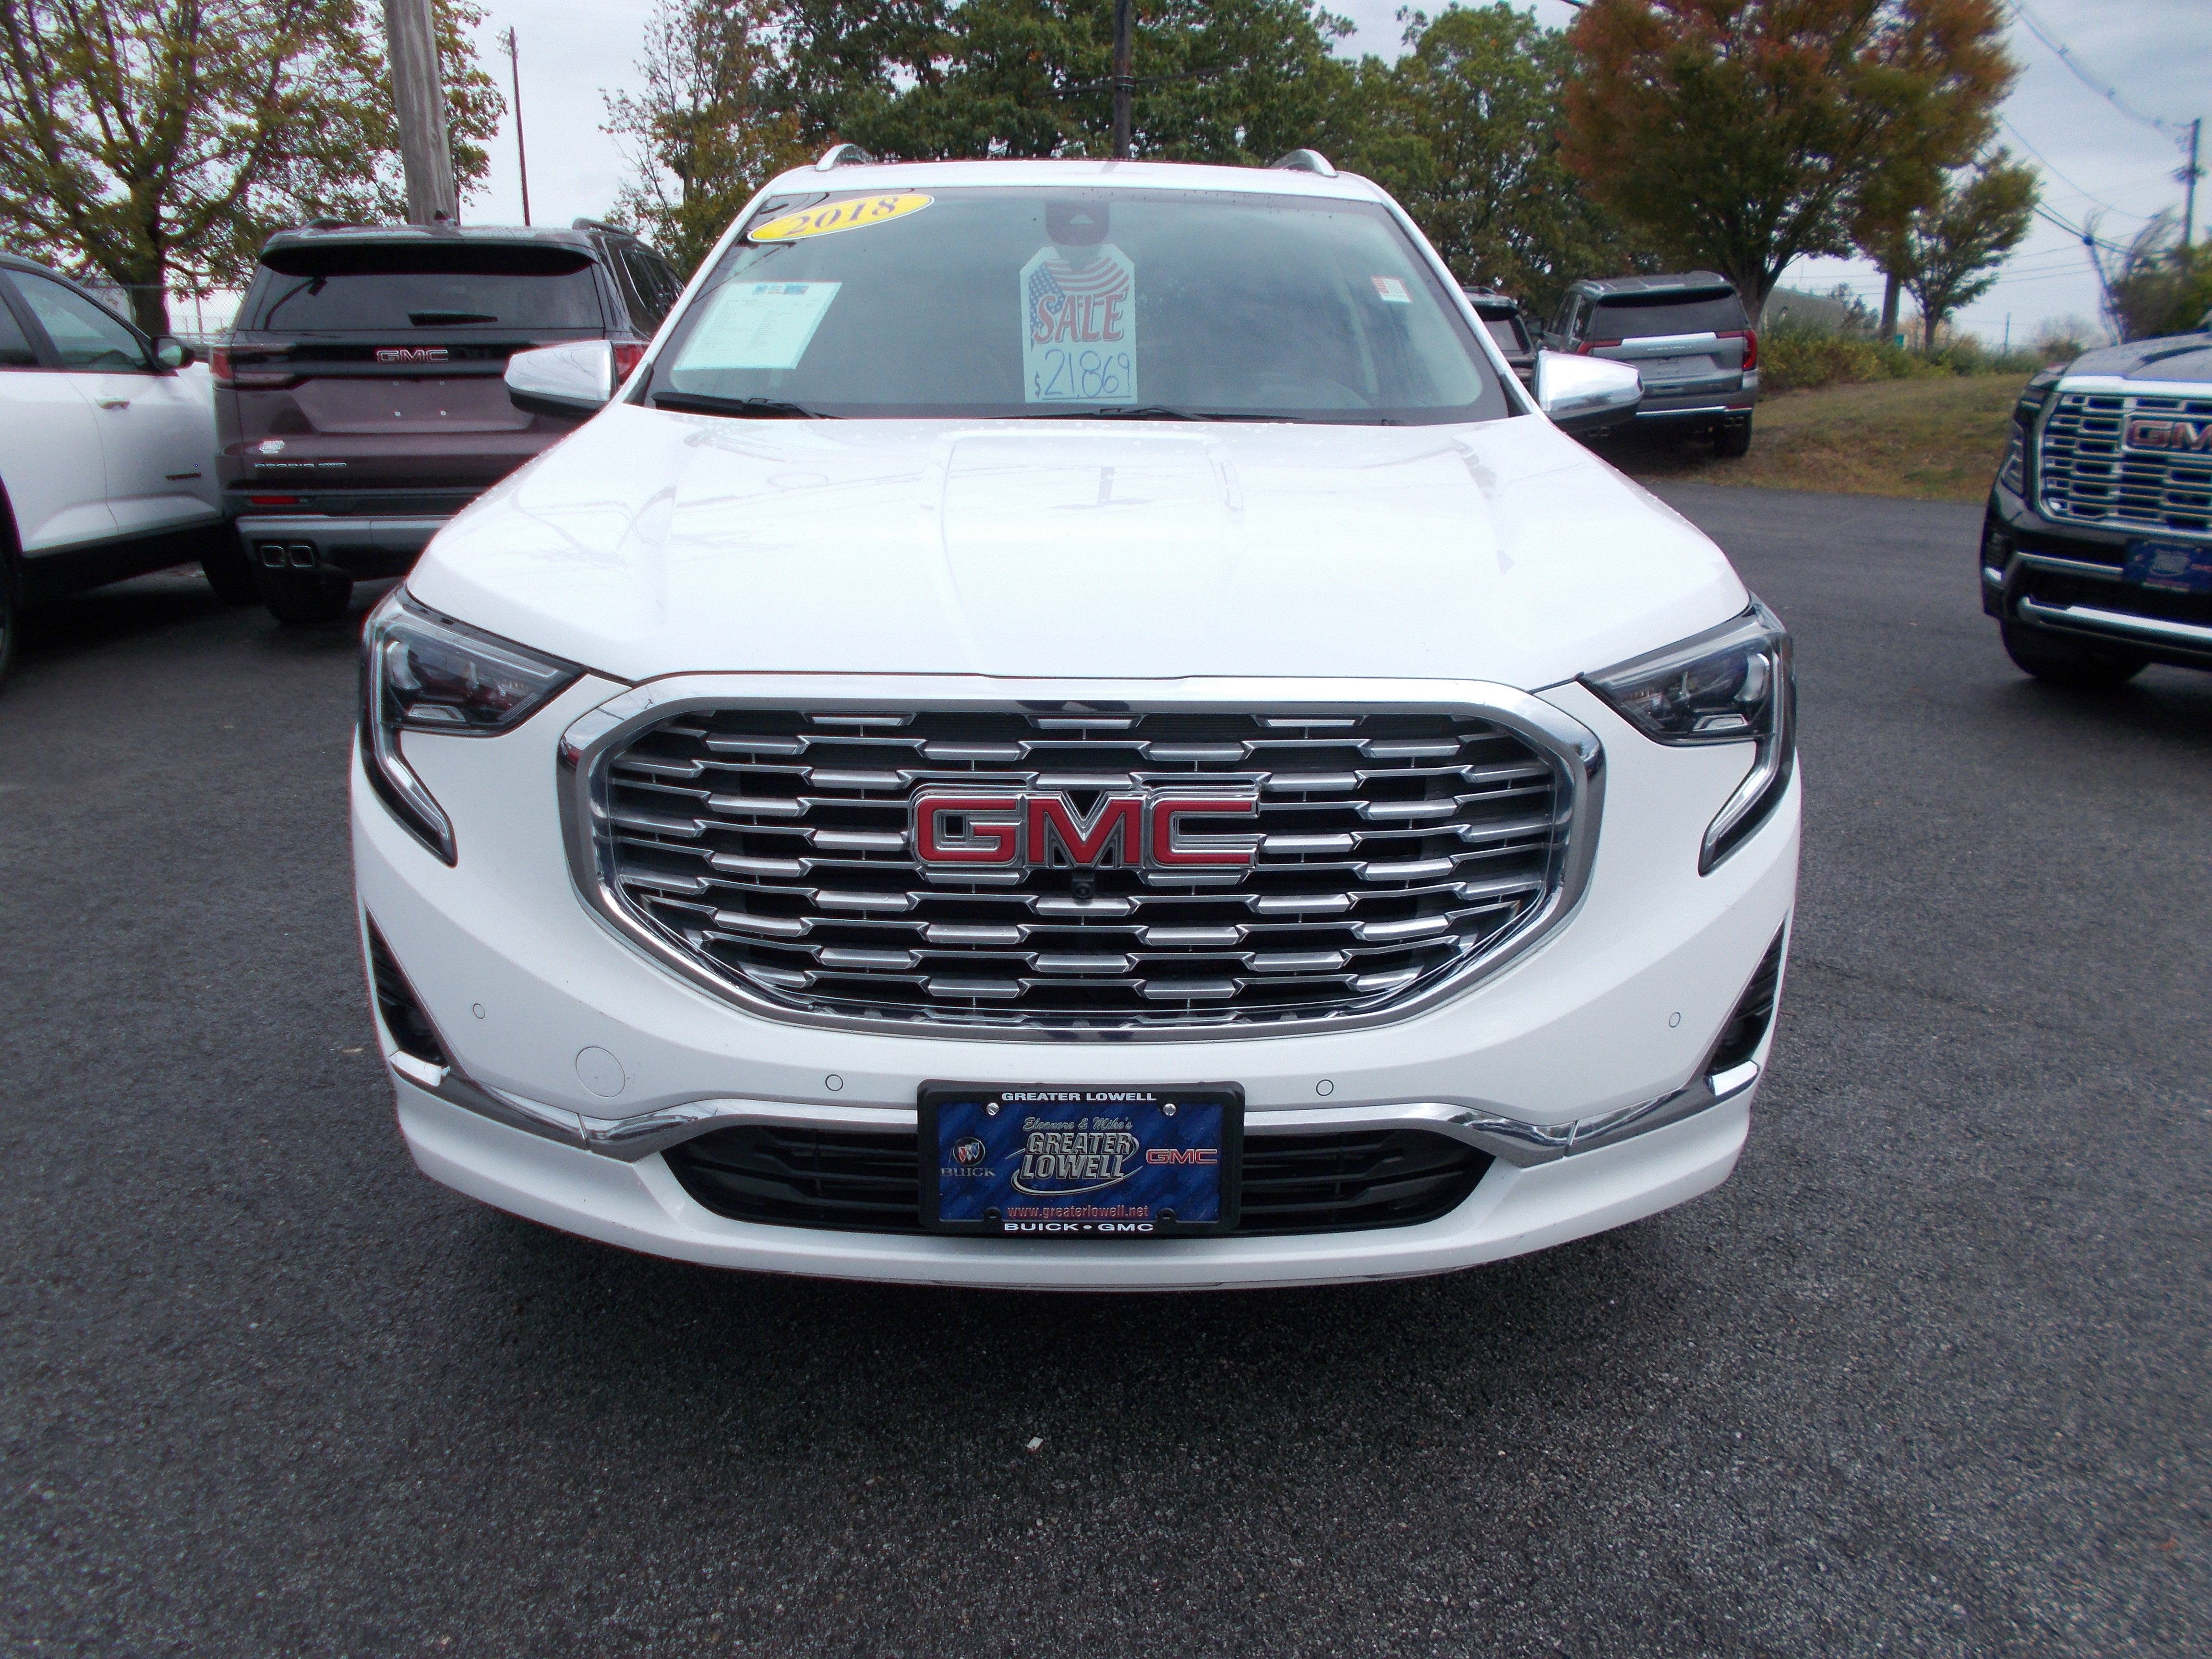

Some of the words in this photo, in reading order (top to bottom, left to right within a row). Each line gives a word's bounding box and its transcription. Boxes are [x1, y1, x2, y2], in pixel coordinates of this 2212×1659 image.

[783, 197, 899, 236] 2018
[1033, 291, 1128, 344] SALE
[377, 349, 449, 364] GMC
[914, 793, 1260, 868] GMC
[1001, 1092, 1081, 1101] GREATER
[1086, 1093, 1157, 1101] LOWELL
[1078, 1117, 1089, 1130] &
[1092, 1117, 1133, 1130] Mike's
[1026, 1132, 1132, 1154] GREATER
[1146, 1149, 1217, 1164] GMC
[940, 1167, 996, 1177] BUICK
[1020, 1154, 1124, 1179] LOWELL
[1008, 1204, 1149, 1219] www.greaterlowell.net
[1004, 1223, 1079, 1231] BUICK
[1098, 1223, 1154, 1232] GMC
